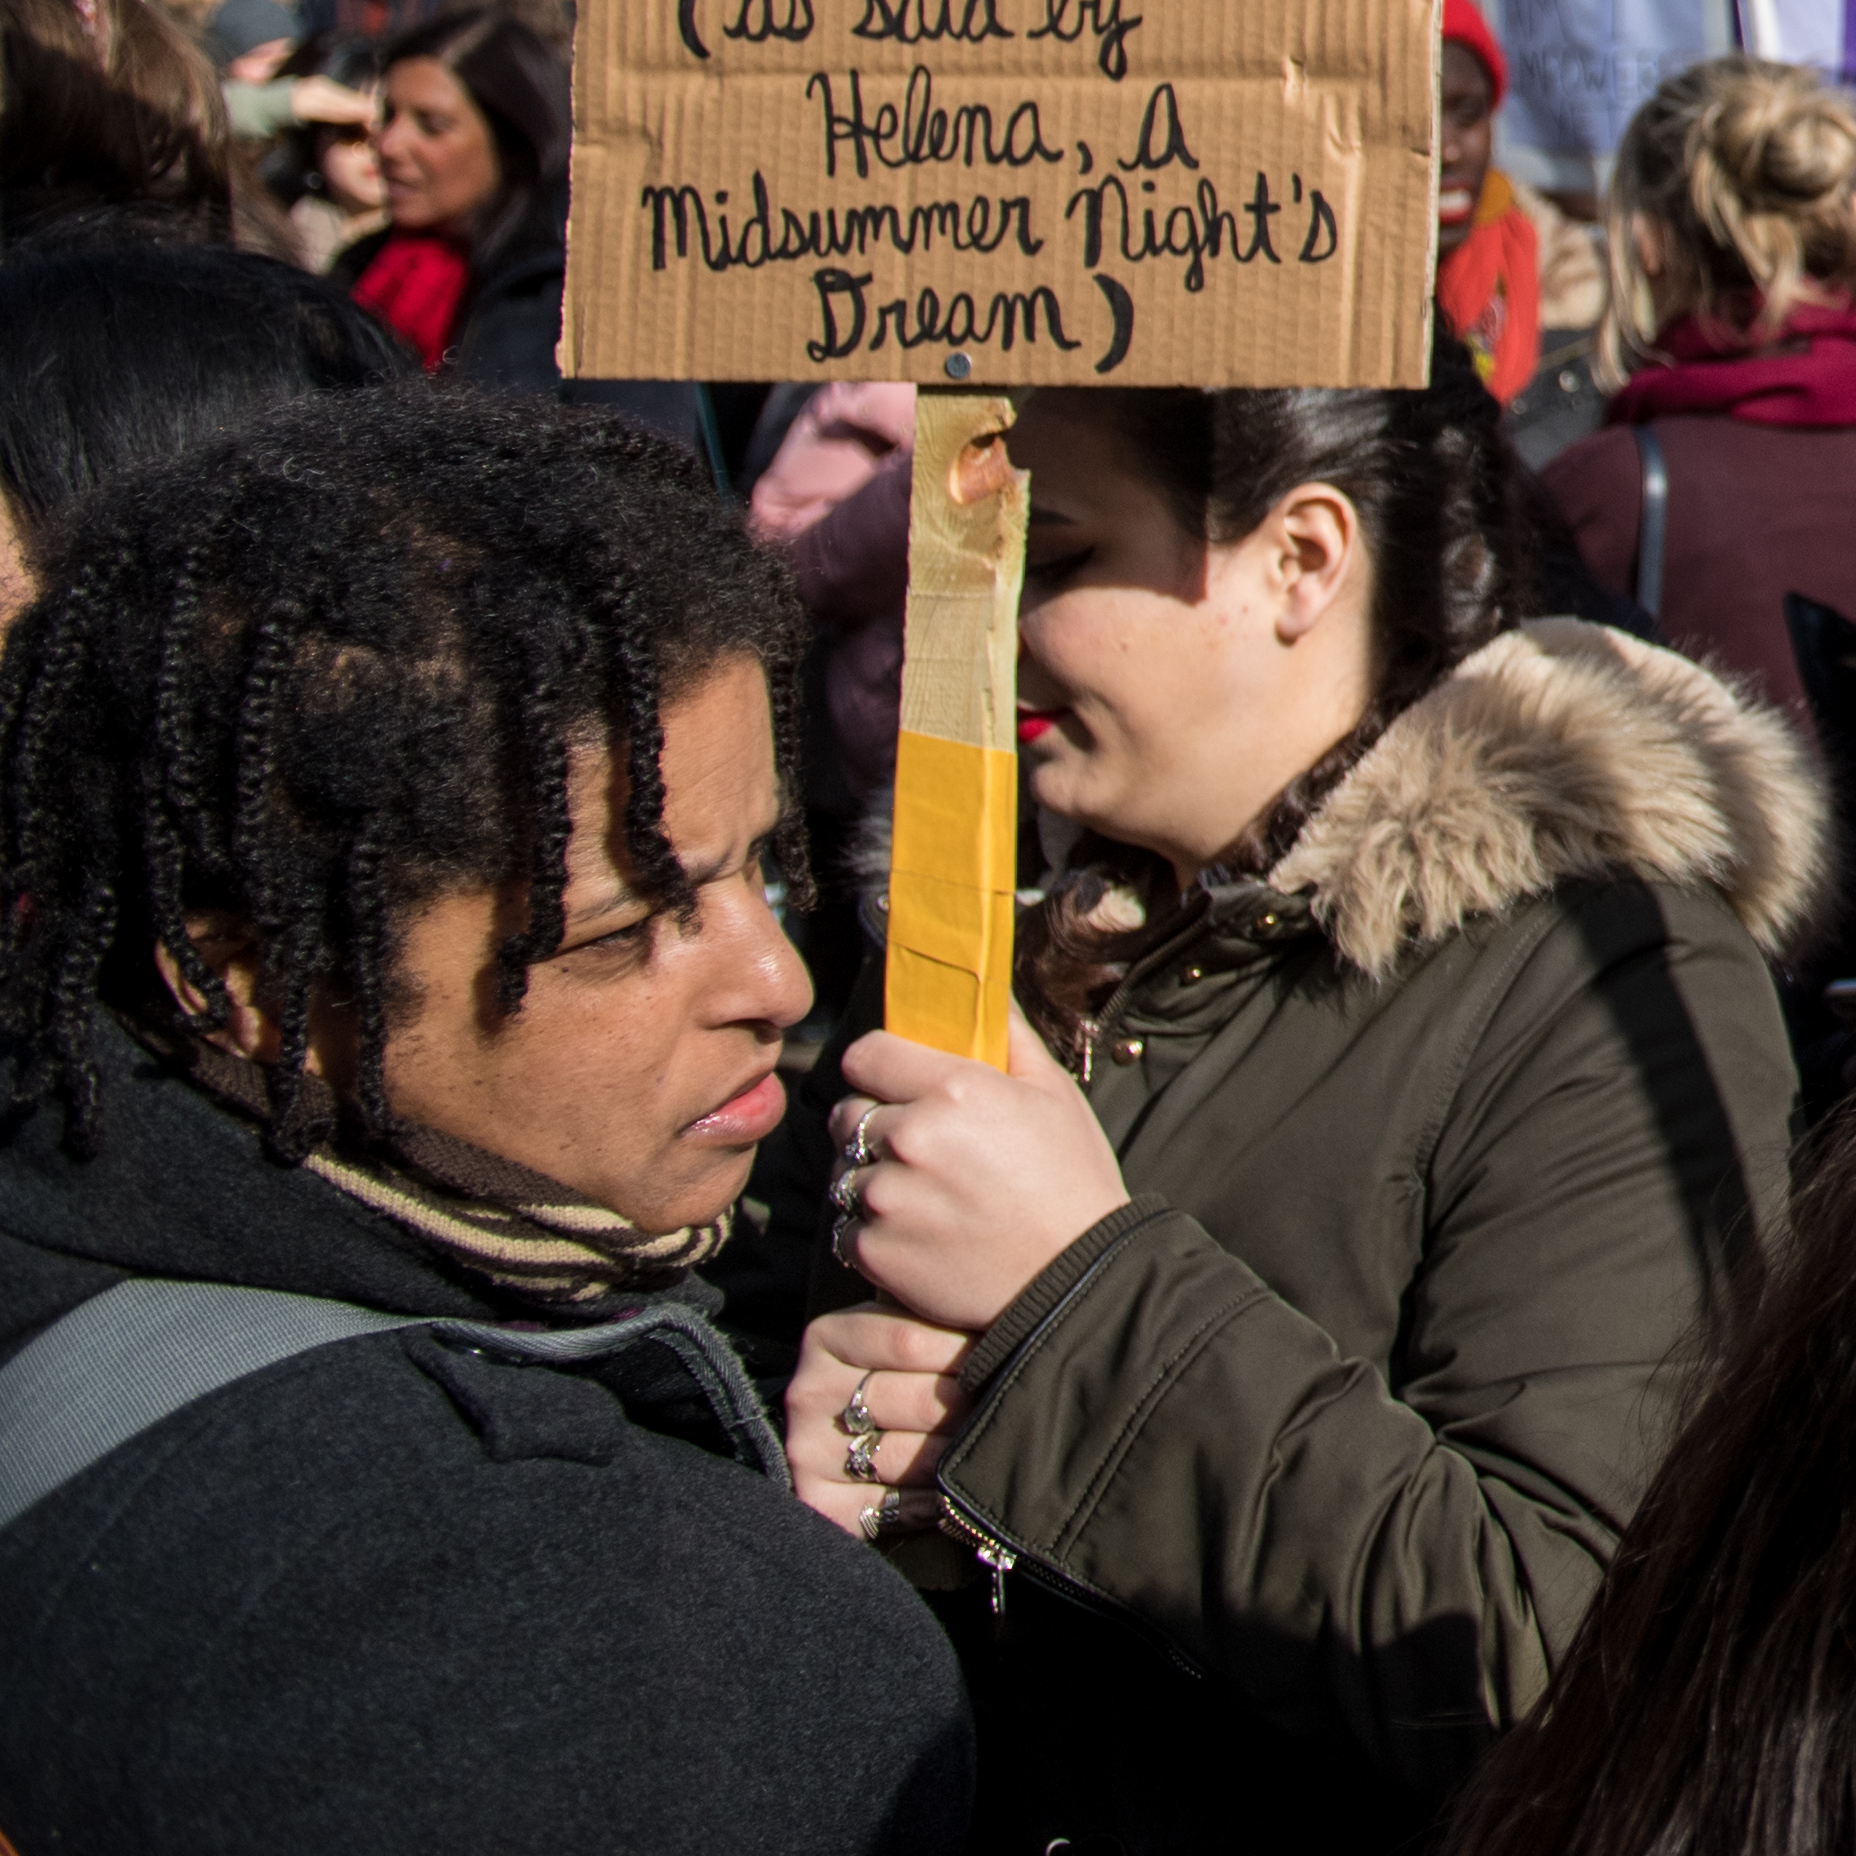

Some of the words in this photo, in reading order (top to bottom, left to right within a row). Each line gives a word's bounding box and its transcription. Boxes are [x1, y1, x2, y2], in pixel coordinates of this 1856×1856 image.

[806, 64, 1093, 178] Helena,
[1117, 83, 1199, 172] A
[641, 169, 1044, 272] Midsummer
[1065, 172, 1339, 293] Night's
[806, 267, 1134, 374] Dream)
